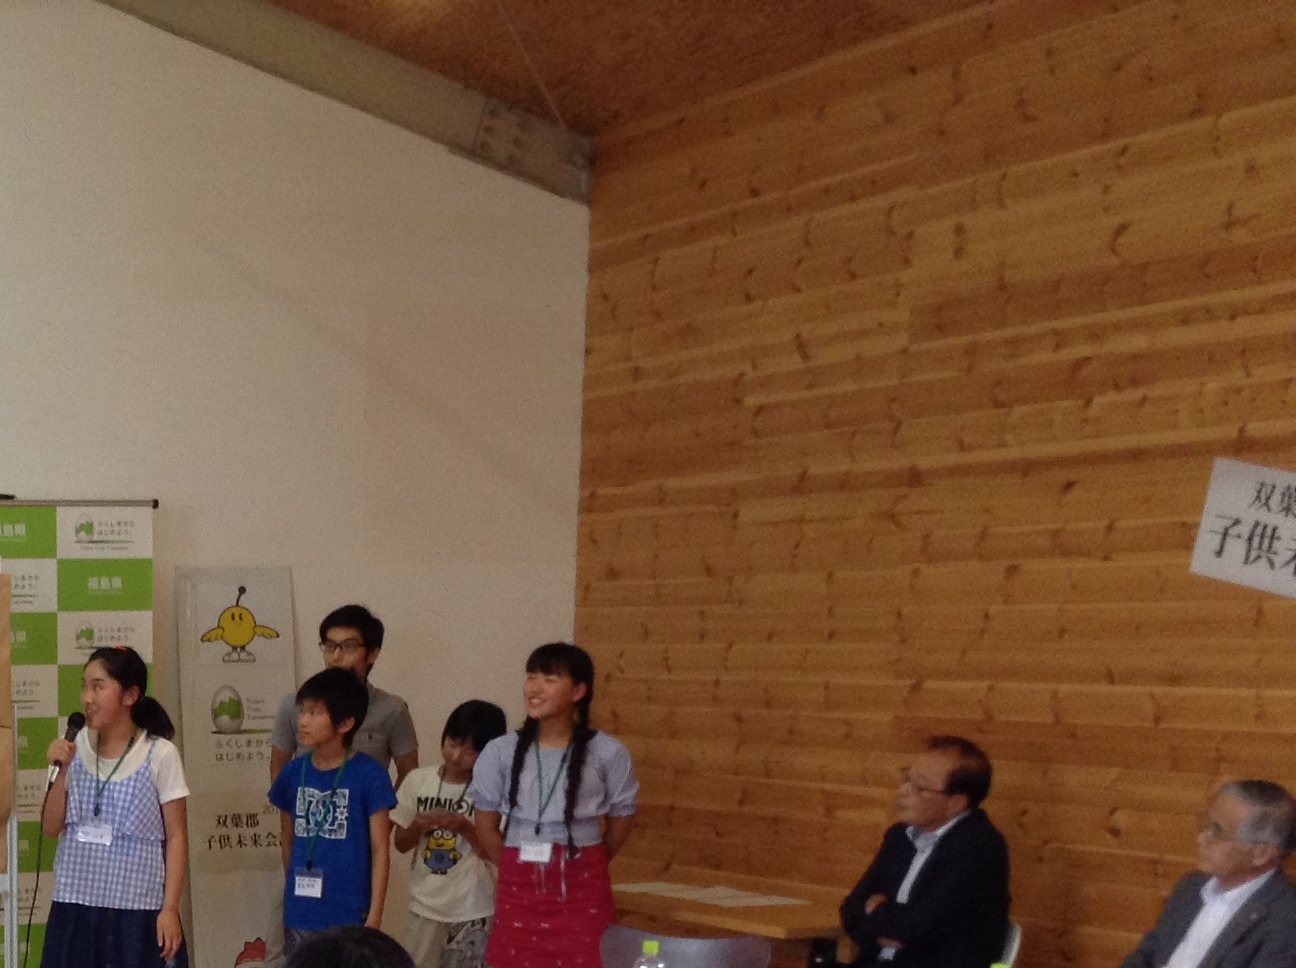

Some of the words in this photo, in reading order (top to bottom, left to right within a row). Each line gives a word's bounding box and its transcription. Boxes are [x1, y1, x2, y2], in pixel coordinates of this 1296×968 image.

[206, 832, 282, 849] 子供未来会
